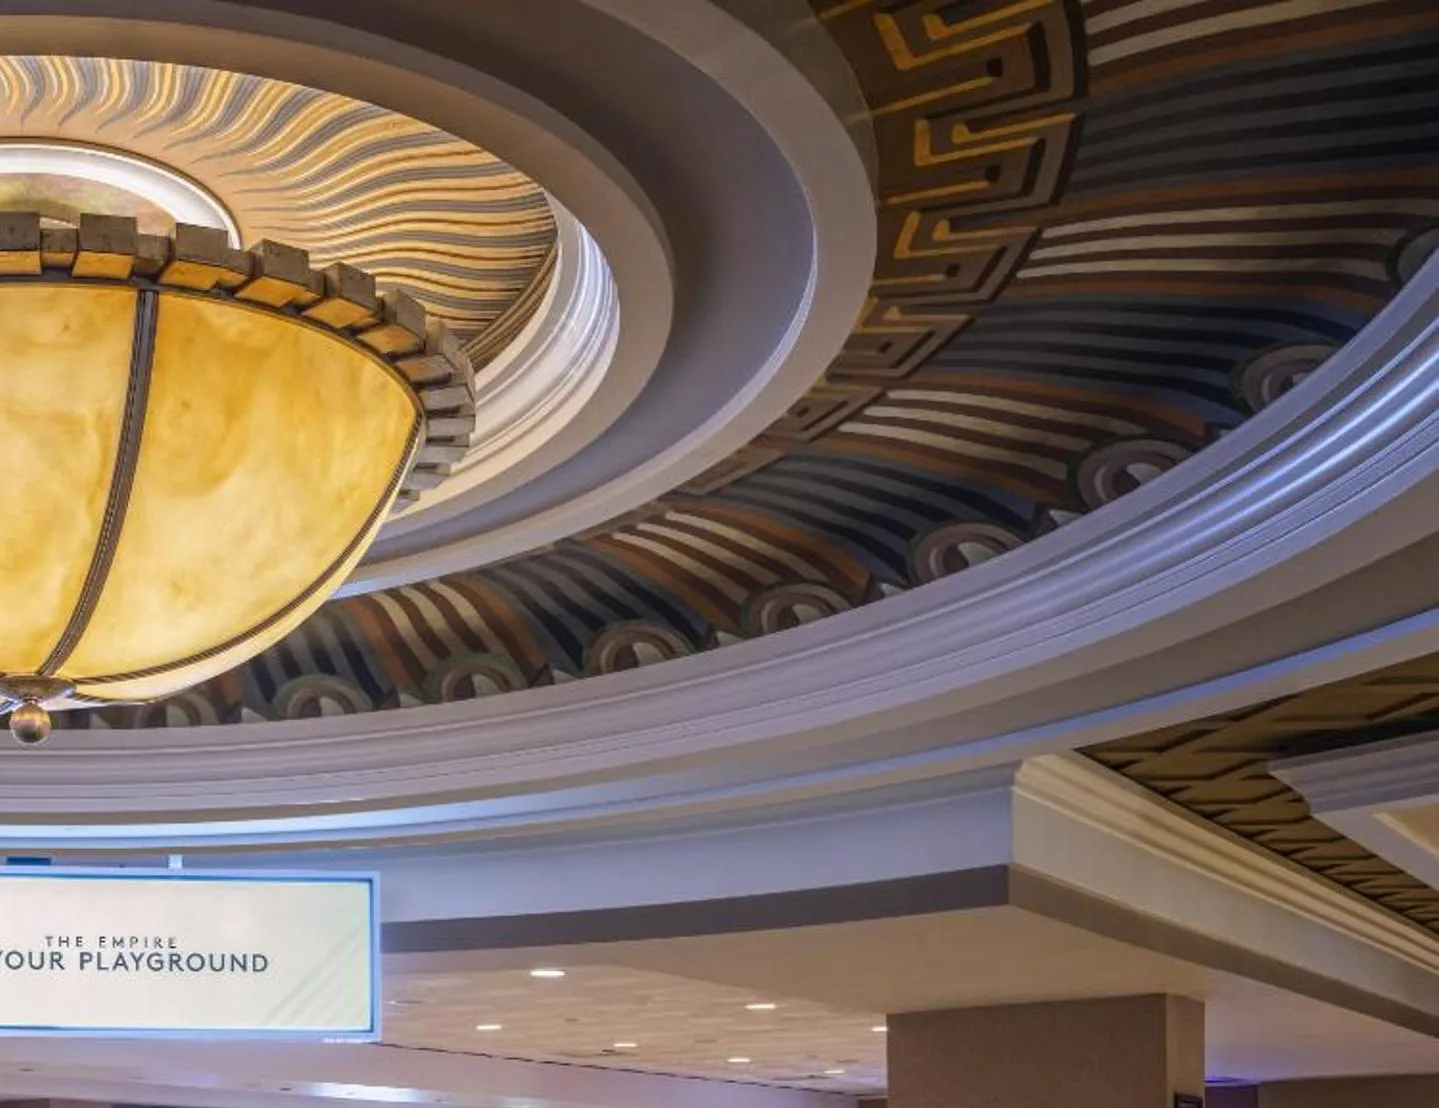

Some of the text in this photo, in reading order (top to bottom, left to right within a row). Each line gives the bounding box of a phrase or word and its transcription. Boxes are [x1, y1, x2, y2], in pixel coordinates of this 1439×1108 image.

[45, 936, 178, 949] THE EMPIRE
[79, 951, 269, 972] PLAYGROUND
